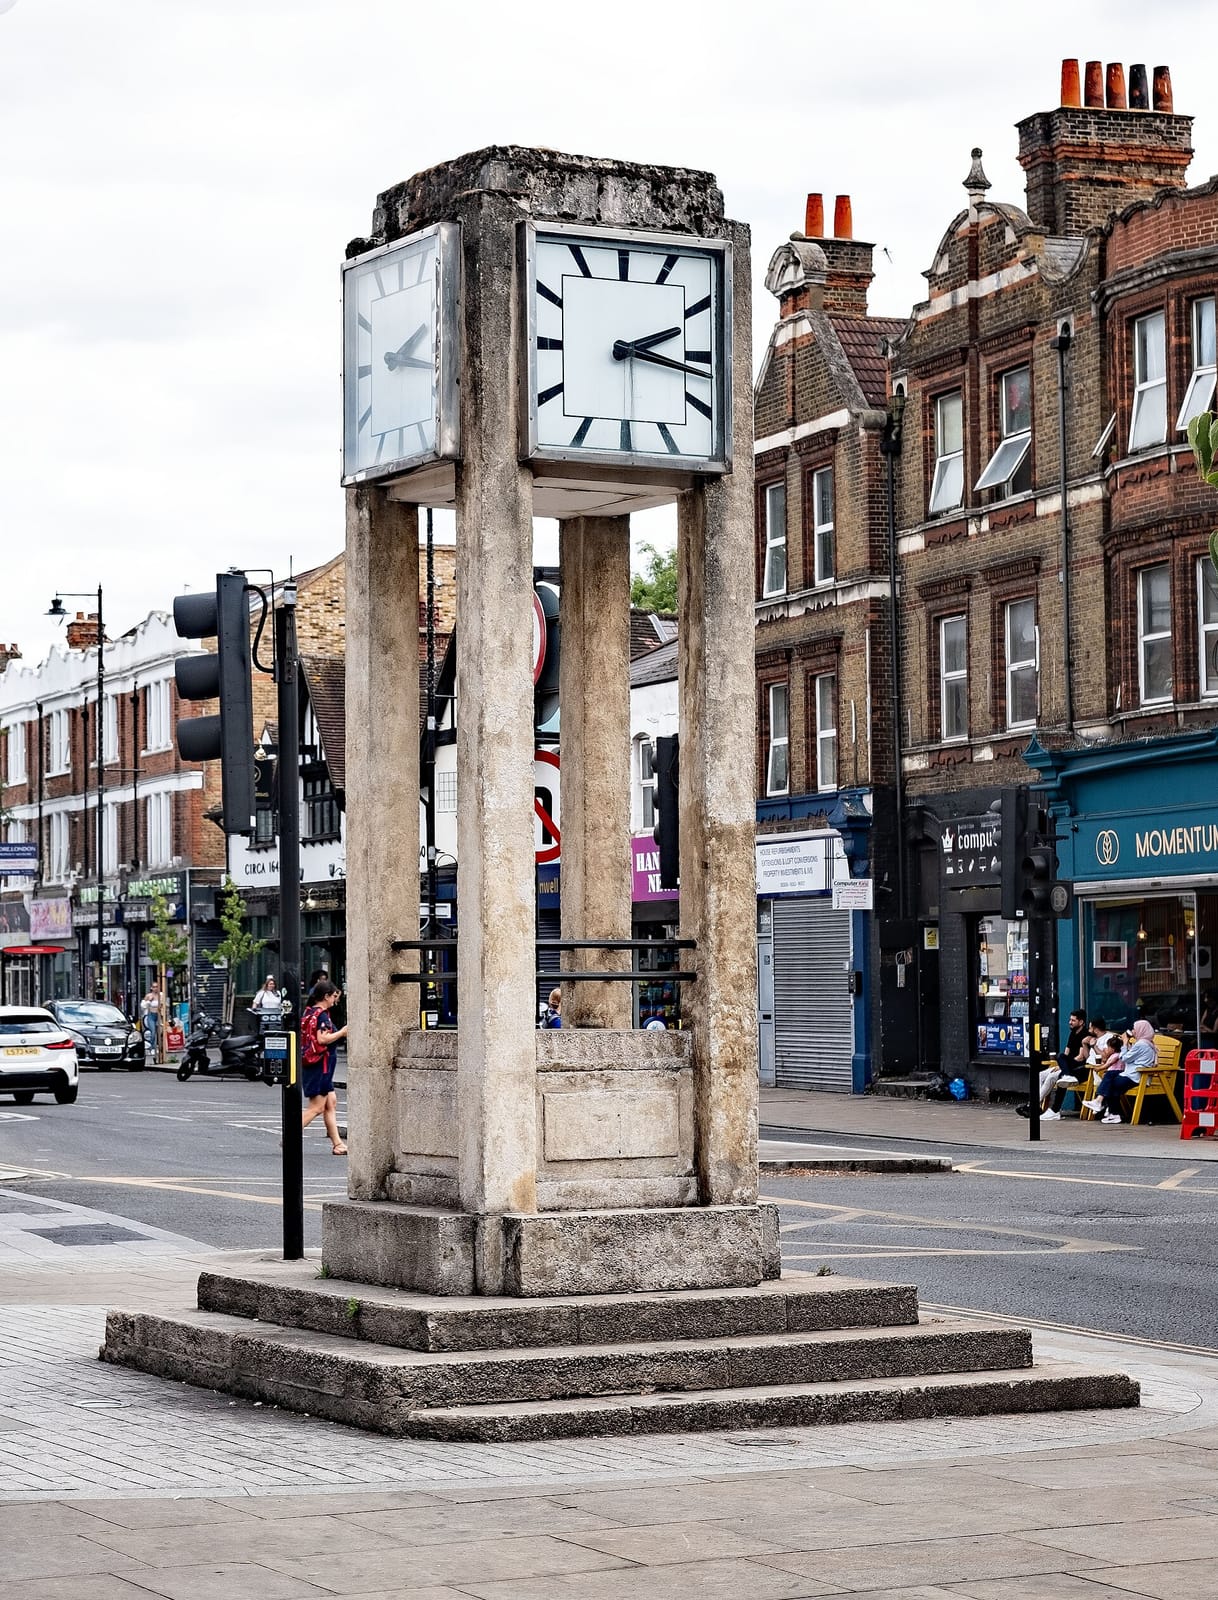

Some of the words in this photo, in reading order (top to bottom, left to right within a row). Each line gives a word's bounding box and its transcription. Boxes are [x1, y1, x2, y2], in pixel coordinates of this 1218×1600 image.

[245, 863, 266, 875] CIRCA
[268, 861, 280, 873] 164
[648, 874, 677, 892] NE
